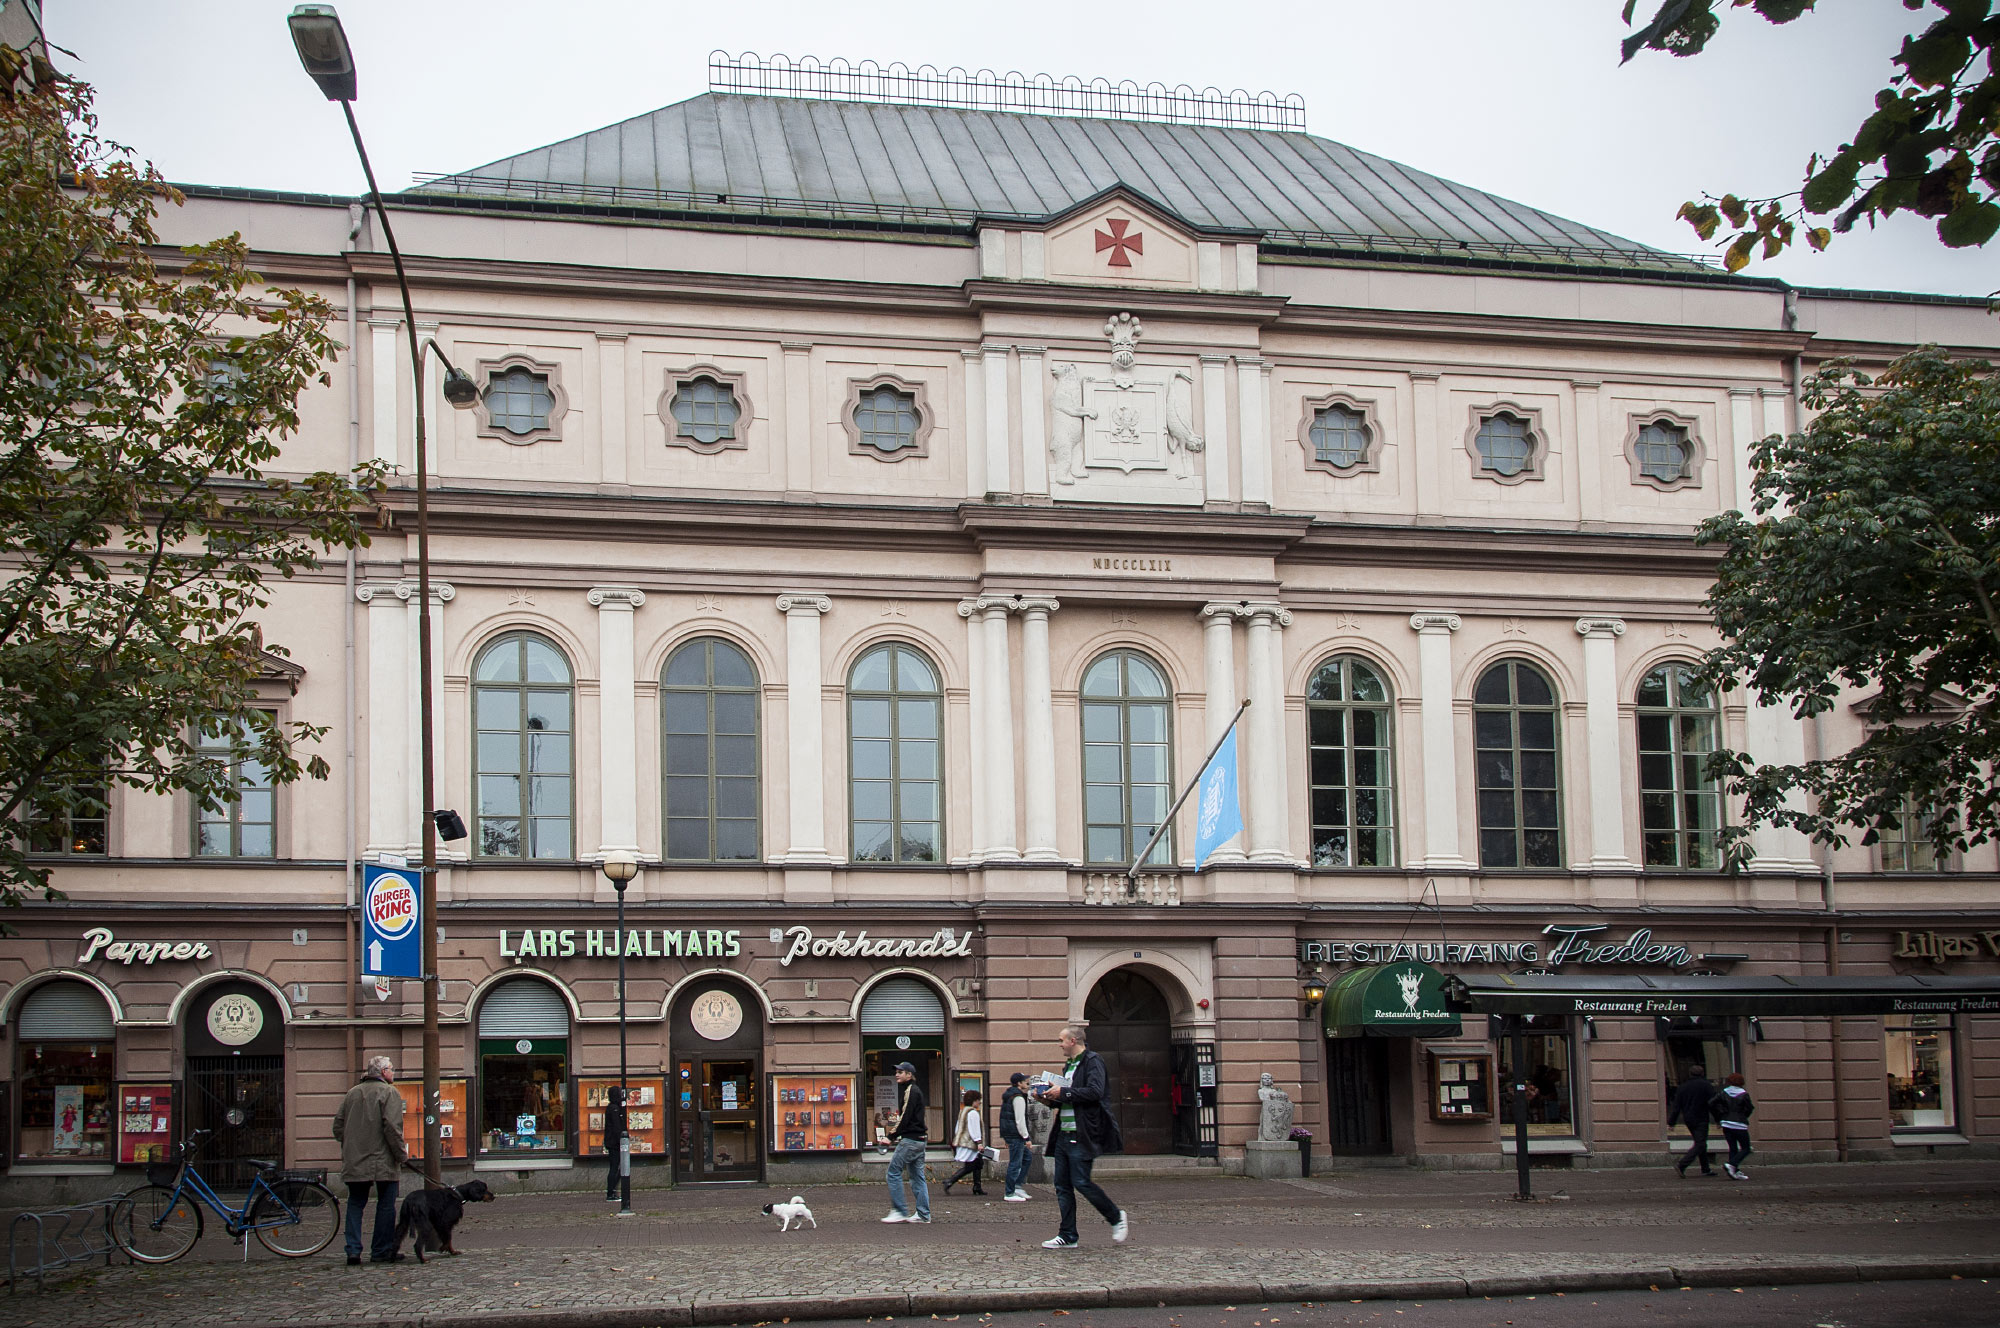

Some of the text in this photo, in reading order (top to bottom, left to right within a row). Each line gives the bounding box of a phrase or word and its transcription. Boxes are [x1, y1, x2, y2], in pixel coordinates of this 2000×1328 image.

[1093, 558, 1171, 571] MDCCCLXIX
[373, 888, 411, 907] BURGER
[374, 899, 412, 923] KING
[78, 927, 213, 965] Papper
[500, 929, 740, 957] LARS HJALMARS
[780, 925, 973, 967] Bokhandel
[1303, 942, 1539, 964] RESTAURANG
[1541, 922, 1693, 968] Freden
[1892, 930, 1979, 964] Liljas
[1374, 1009, 1450, 1020] Restaurang Freden
[1574, 999, 1688, 1012] Restaurang Freden
[1893, 997, 2000, 1011] Restaurang Freden
